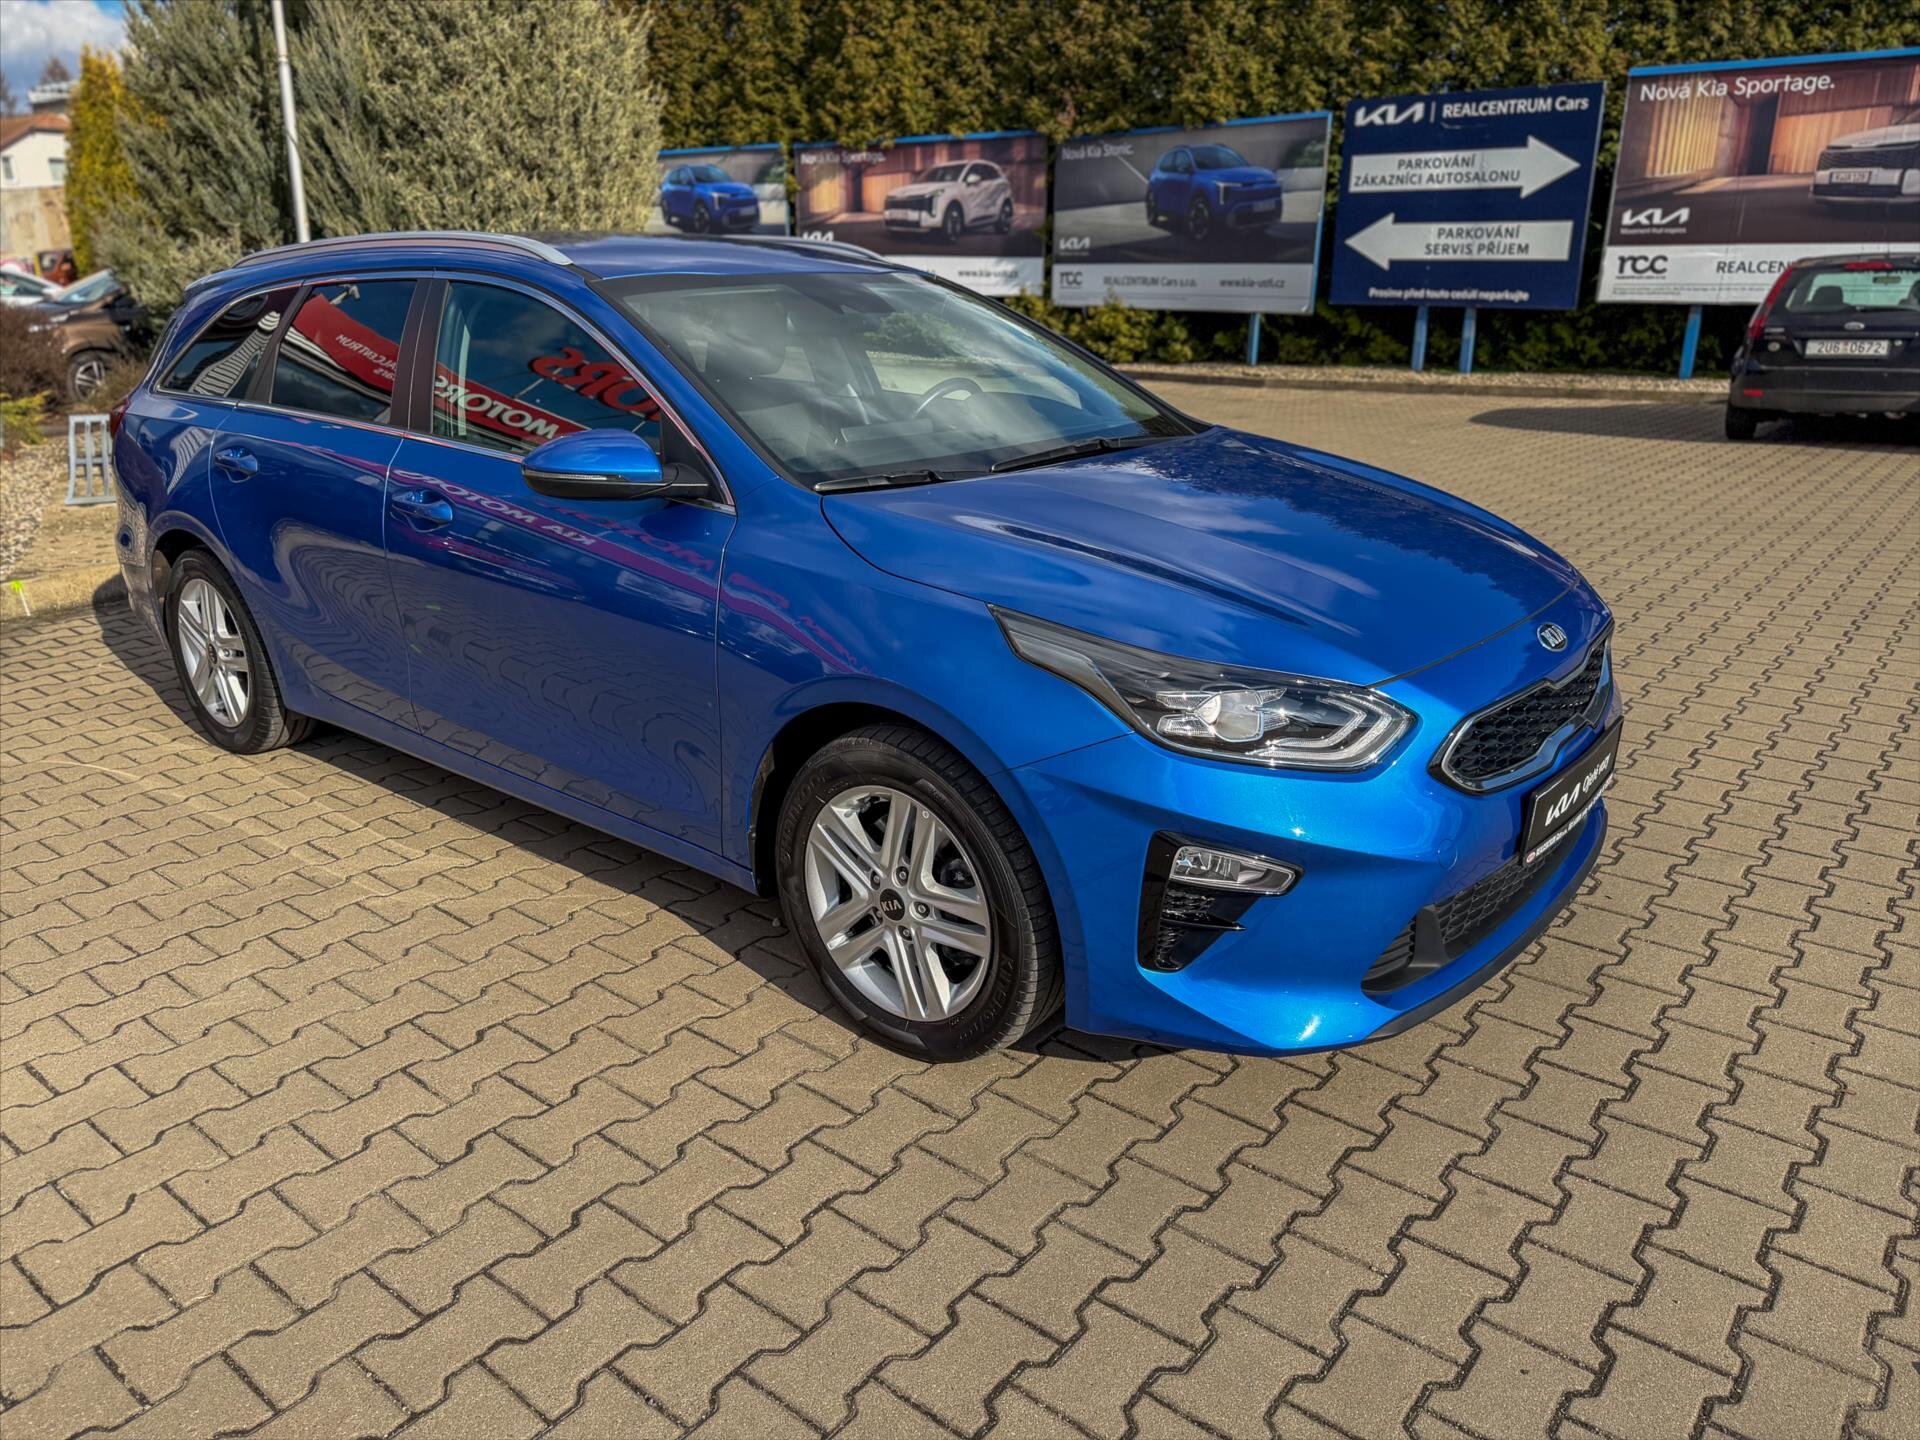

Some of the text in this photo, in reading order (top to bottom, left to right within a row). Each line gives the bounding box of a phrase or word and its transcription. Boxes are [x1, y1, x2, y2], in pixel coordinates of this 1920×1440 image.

[1640, 74, 1836, 102] Nová Kia Sportage.
[1354, 96, 1589, 127] KIA REALCENTRUM Cars
[1397, 154, 1477, 169] PARKOVÁNÍ
[1353, 170, 1521, 187] ZÁKAZNÍCI AUTOSALONU
[1621, 207, 1690, 226] KIA
[1437, 224, 1521, 239] PARKOVÁNÍ
[1424, 240, 1530, 256] SERVIS PŘÍJEM
[880, 899, 903, 912] KIA
